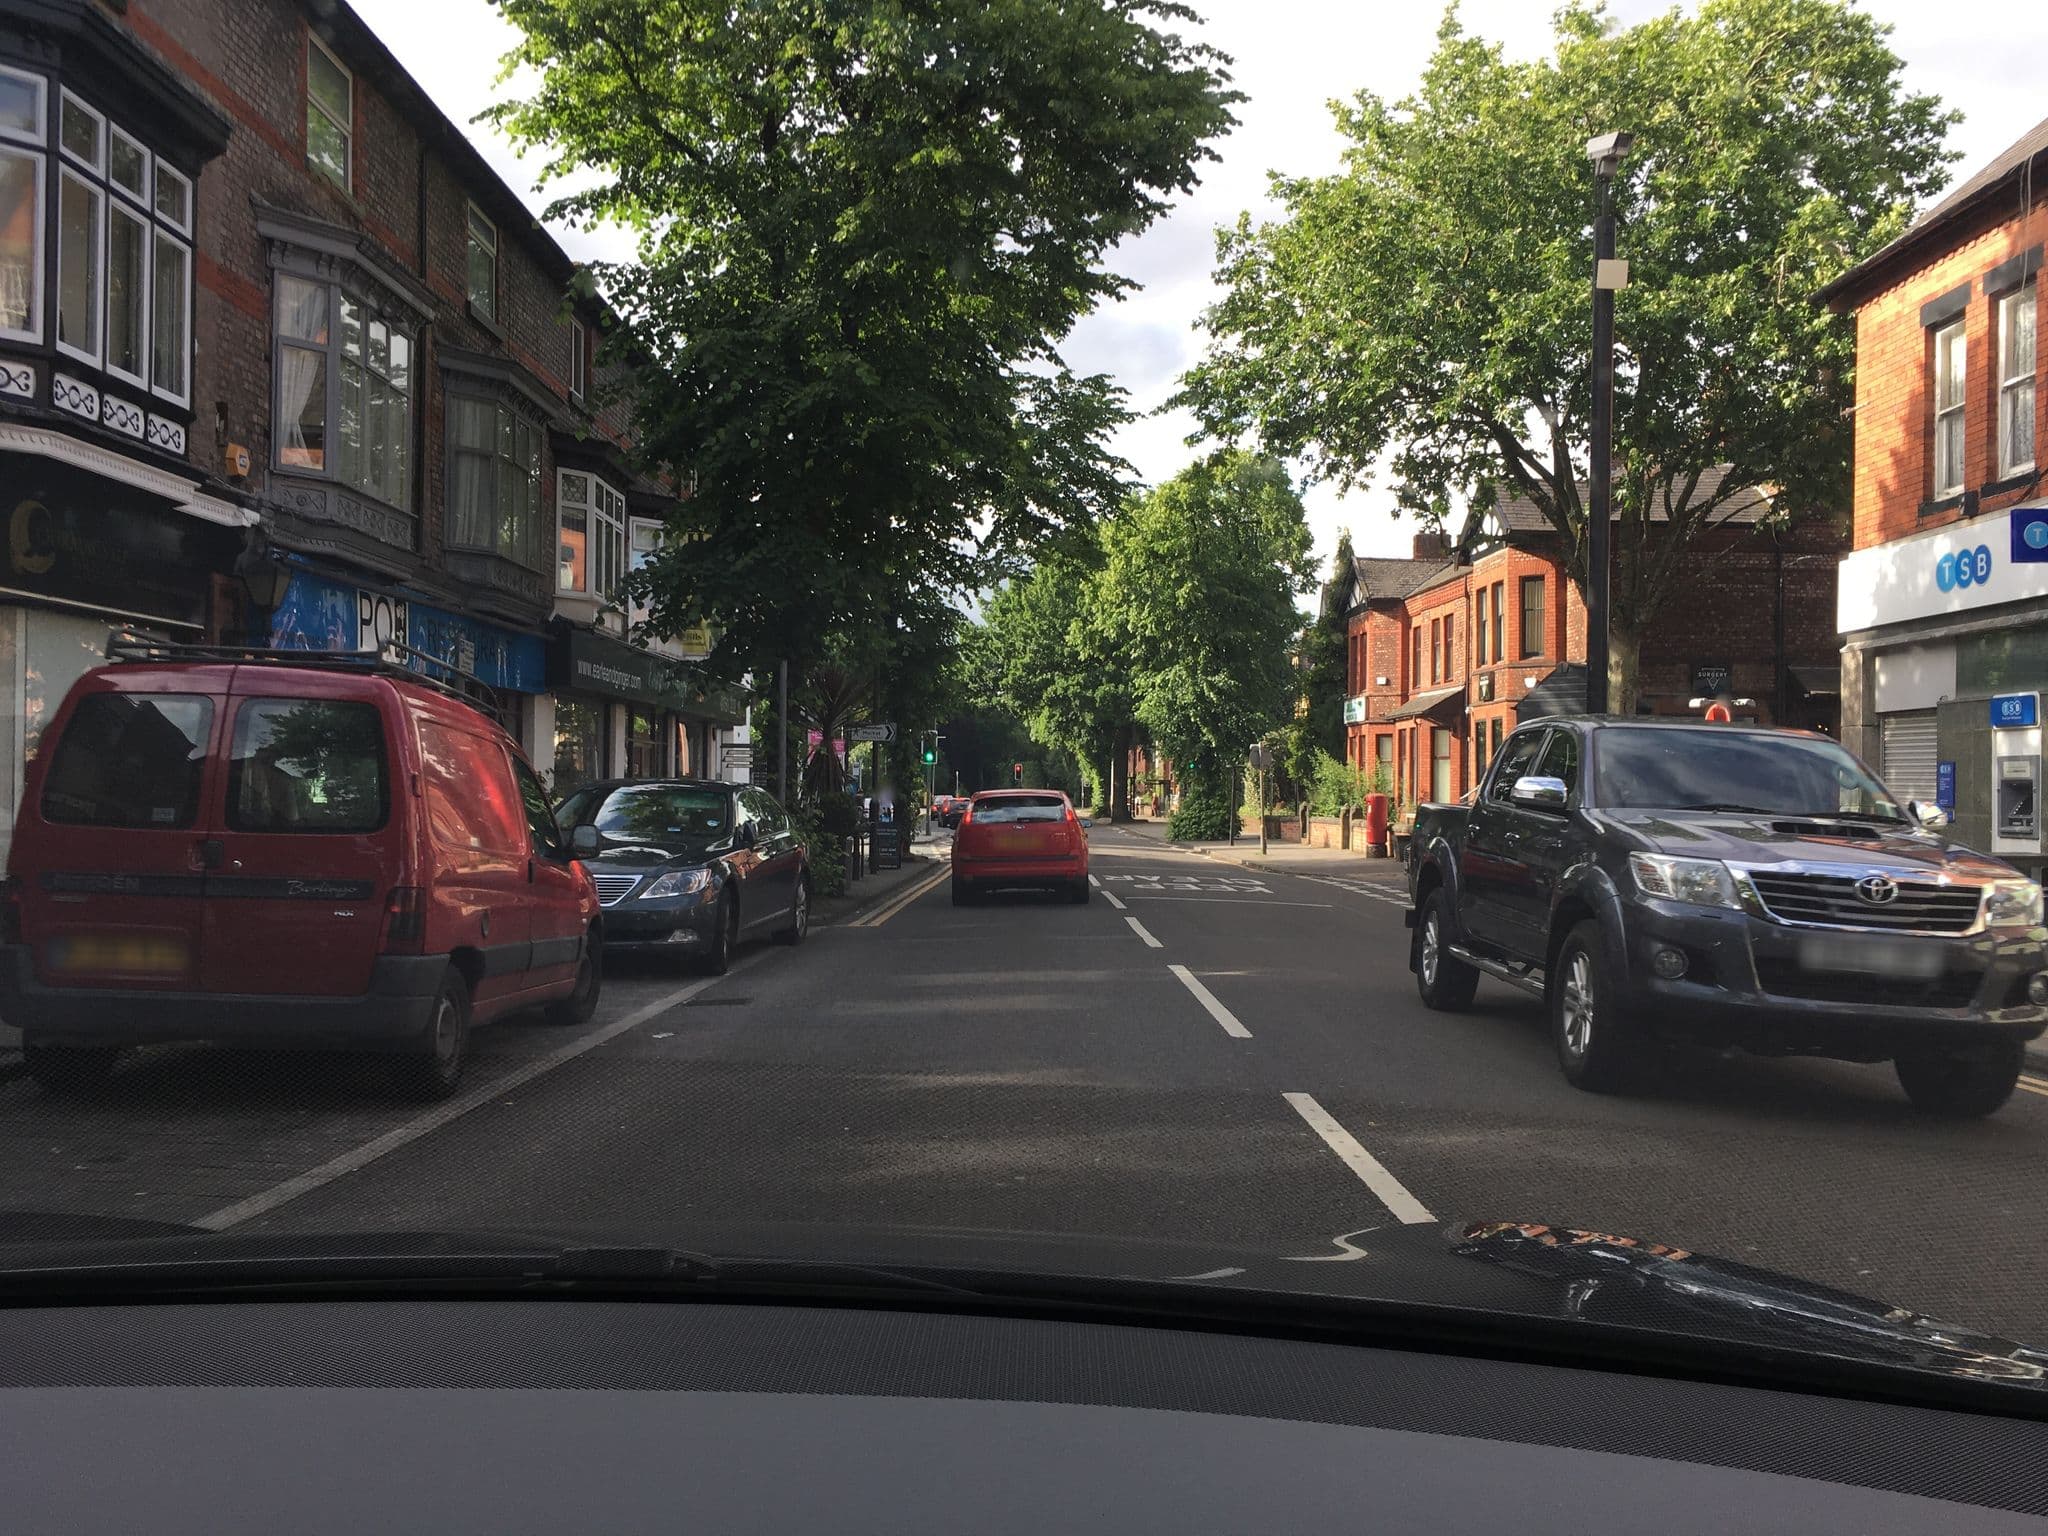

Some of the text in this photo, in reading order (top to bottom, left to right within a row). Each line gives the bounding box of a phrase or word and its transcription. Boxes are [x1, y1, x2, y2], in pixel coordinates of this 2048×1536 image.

[1940, 549, 1989, 588] TSB
[2002, 702, 2021, 714] TSB
[1104, 874, 1266, 885] CLEAR
[287, 880, 358, 897] Berlingo
[1134, 883, 1274, 894] KEEP
